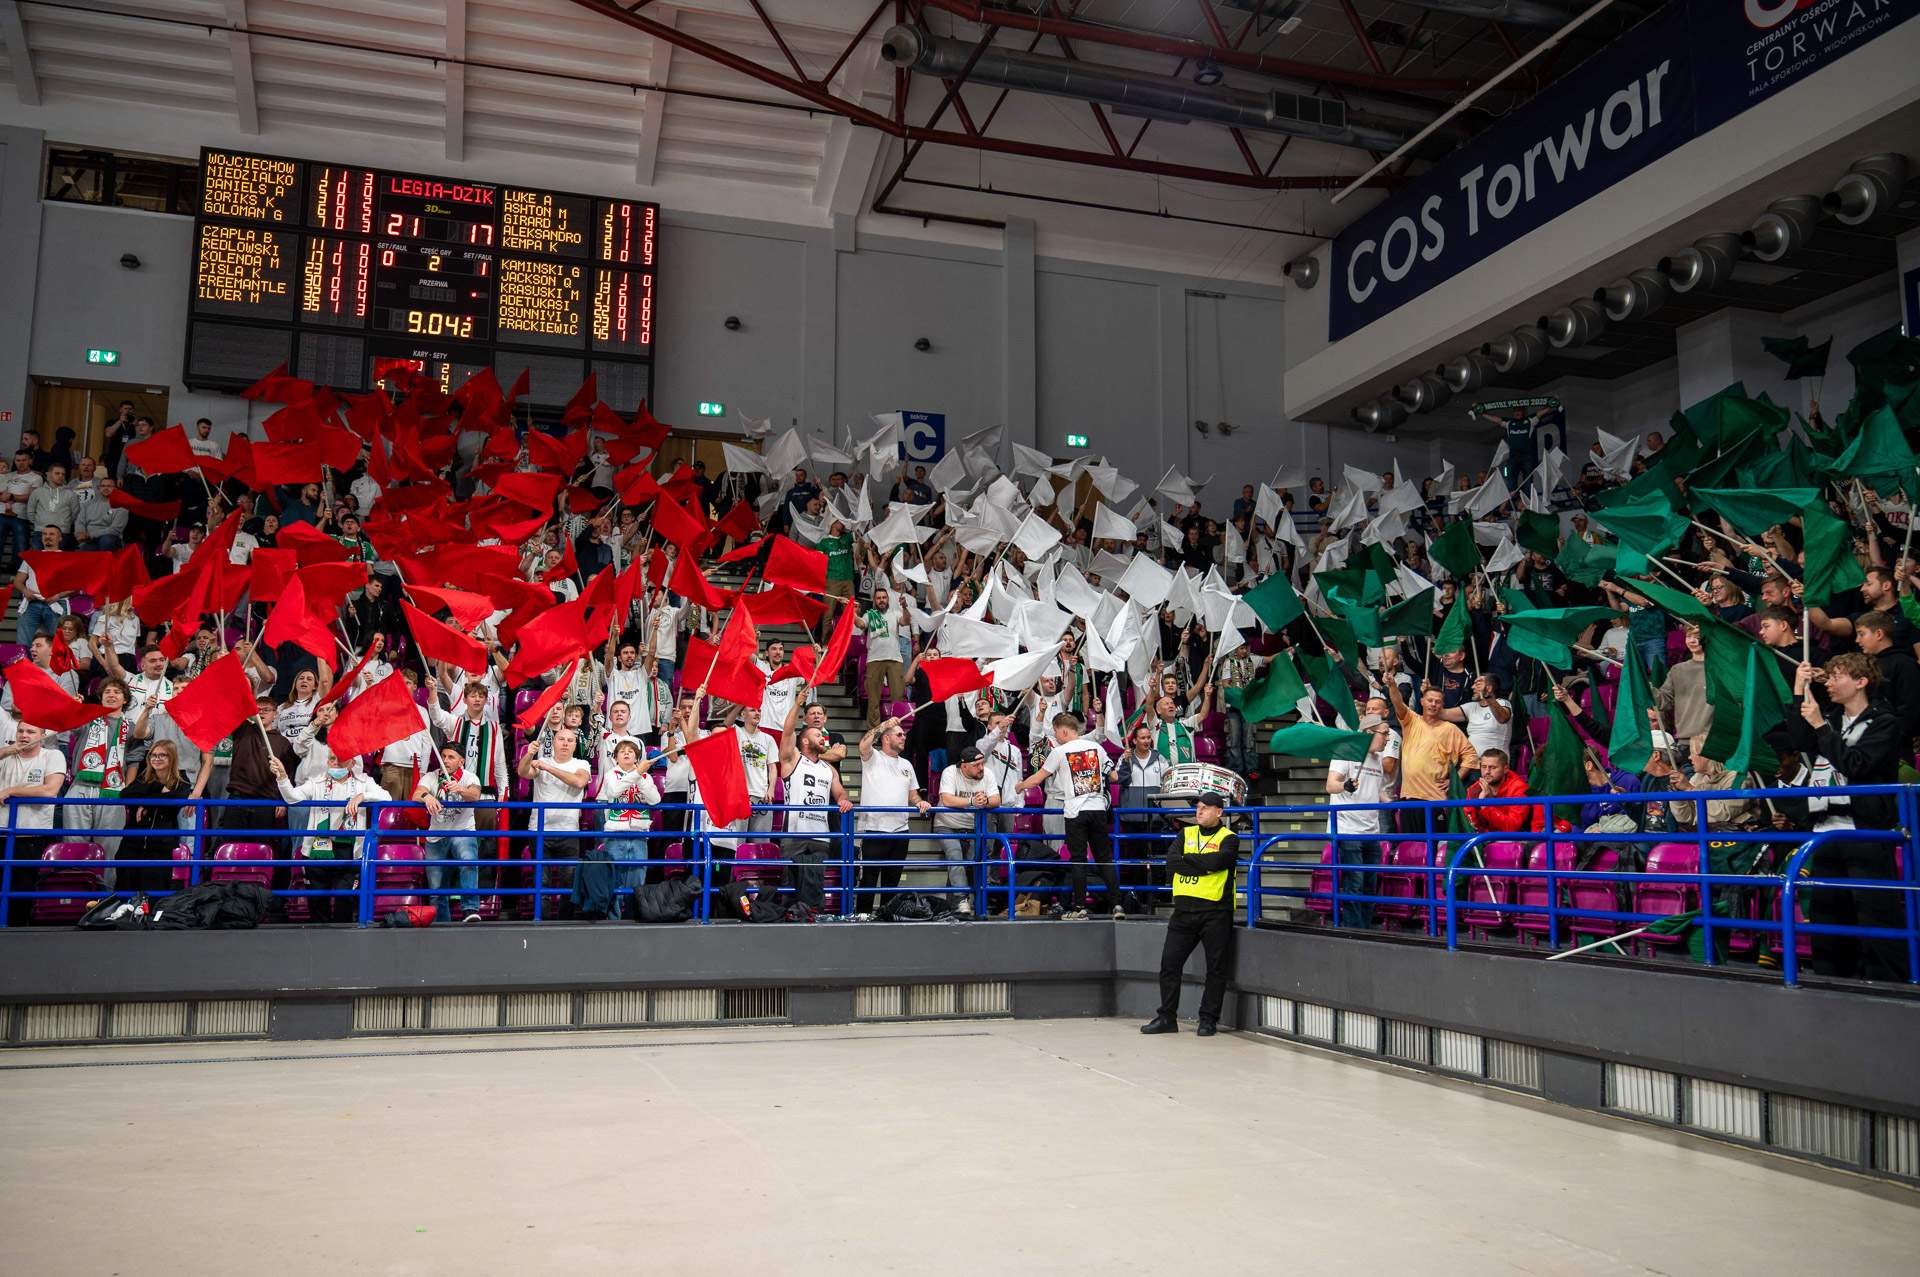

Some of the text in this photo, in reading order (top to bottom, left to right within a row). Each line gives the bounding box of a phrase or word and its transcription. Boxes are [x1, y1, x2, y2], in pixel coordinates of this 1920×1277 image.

[1746, 0, 1840, 56] CENTRALNY OŚROD
[1749, 12, 1891, 96] HALA SPORTOWO WIDOWISKOWA
[207, 165, 373, 197] NIEDZIALKO 2 0 0
[208, 153, 295, 174] WOJCIECHOW
[364, 173, 374, 186] 3
[1347, 59, 1671, 305] COS Torwar
[205, 189, 372, 220] ZORIKS K 6 0 2
[206, 177, 372, 209] DANIELS A 3 0 2
[391, 177, 493, 205] LEGIA-DZIK
[504, 190, 537, 204] LUKE
[543, 195, 552, 206] A
[621, 205, 630, 217] 0
[645, 208, 654, 220] 3
[204, 201, 371, 232] GOLOMAN G 7 0 3
[387, 213, 419, 237] 21
[503, 213, 551, 229] GIRARD
[558, 220, 567, 231] J
[605, 226, 613, 237] 3
[644, 230, 653, 242] 2
[504, 202, 552, 218] ASHTON
[558, 208, 567, 219] M
[604, 214, 613, 226] 2
[645, 219, 653, 230] 4
[202, 225, 255, 242] CZAPLA
[263, 232, 273, 244] B
[312, 238, 324, 250] 11
[360, 244, 369, 256] 0
[377, 242, 408, 252] SET/FAUL
[470, 224, 493, 246] 17
[503, 225, 582, 244] ALEKSANDRO
[604, 237, 612, 249] 5
[644, 242, 652, 253] 0
[200, 249, 262, 267] KOLENDA
[270, 257, 280, 269] M
[305, 262, 323, 275] 23
[359, 268, 368, 280] 4
[201, 237, 368, 268] REDLOWSKI 17 0 0
[382, 250, 394, 266] 0
[428, 255, 441, 272] 2
[439, 249, 452, 257] GRY
[463, 252, 493, 261] SET/FAUL
[502, 236, 652, 265] KEMPA K 8 0 3
[199, 261, 367, 292] PISLA K 30 0 0
[418, 278, 448, 288] PRZERWA
[501, 258, 564, 276] KAMINSKI
[571, 266, 580, 278] G
[600, 270, 611, 282] 11
[643, 275, 652, 286] 0
[501, 271, 557, 287] JACKSON
[563, 277, 572, 289] Q
[600, 282, 610, 294] 13
[619, 284, 627, 296] 2
[198, 274, 367, 303] FREEMANTLE 32 0 4
[199, 286, 242, 302] ILVER
[250, 292, 260, 304] M
[303, 298, 320, 312] 35
[356, 303, 366, 316] 3
[500, 282, 651, 309] KRASUSKI M 21 0 0
[499, 306, 650, 332] OSUNNIYI O 23 0 4
[500, 294, 650, 321] ADETUKASI 22 0 0
[498, 317, 578, 335] FRACKIEWIC
[593, 328, 608, 340] 45
[641, 332, 649, 344] 0
[412, 350, 429, 358] KARY
[432, 351, 448, 360] SETY
[441, 363, 450, 374] 2
[441, 374, 449, 385] 4
[904, 422, 937, 460] C
